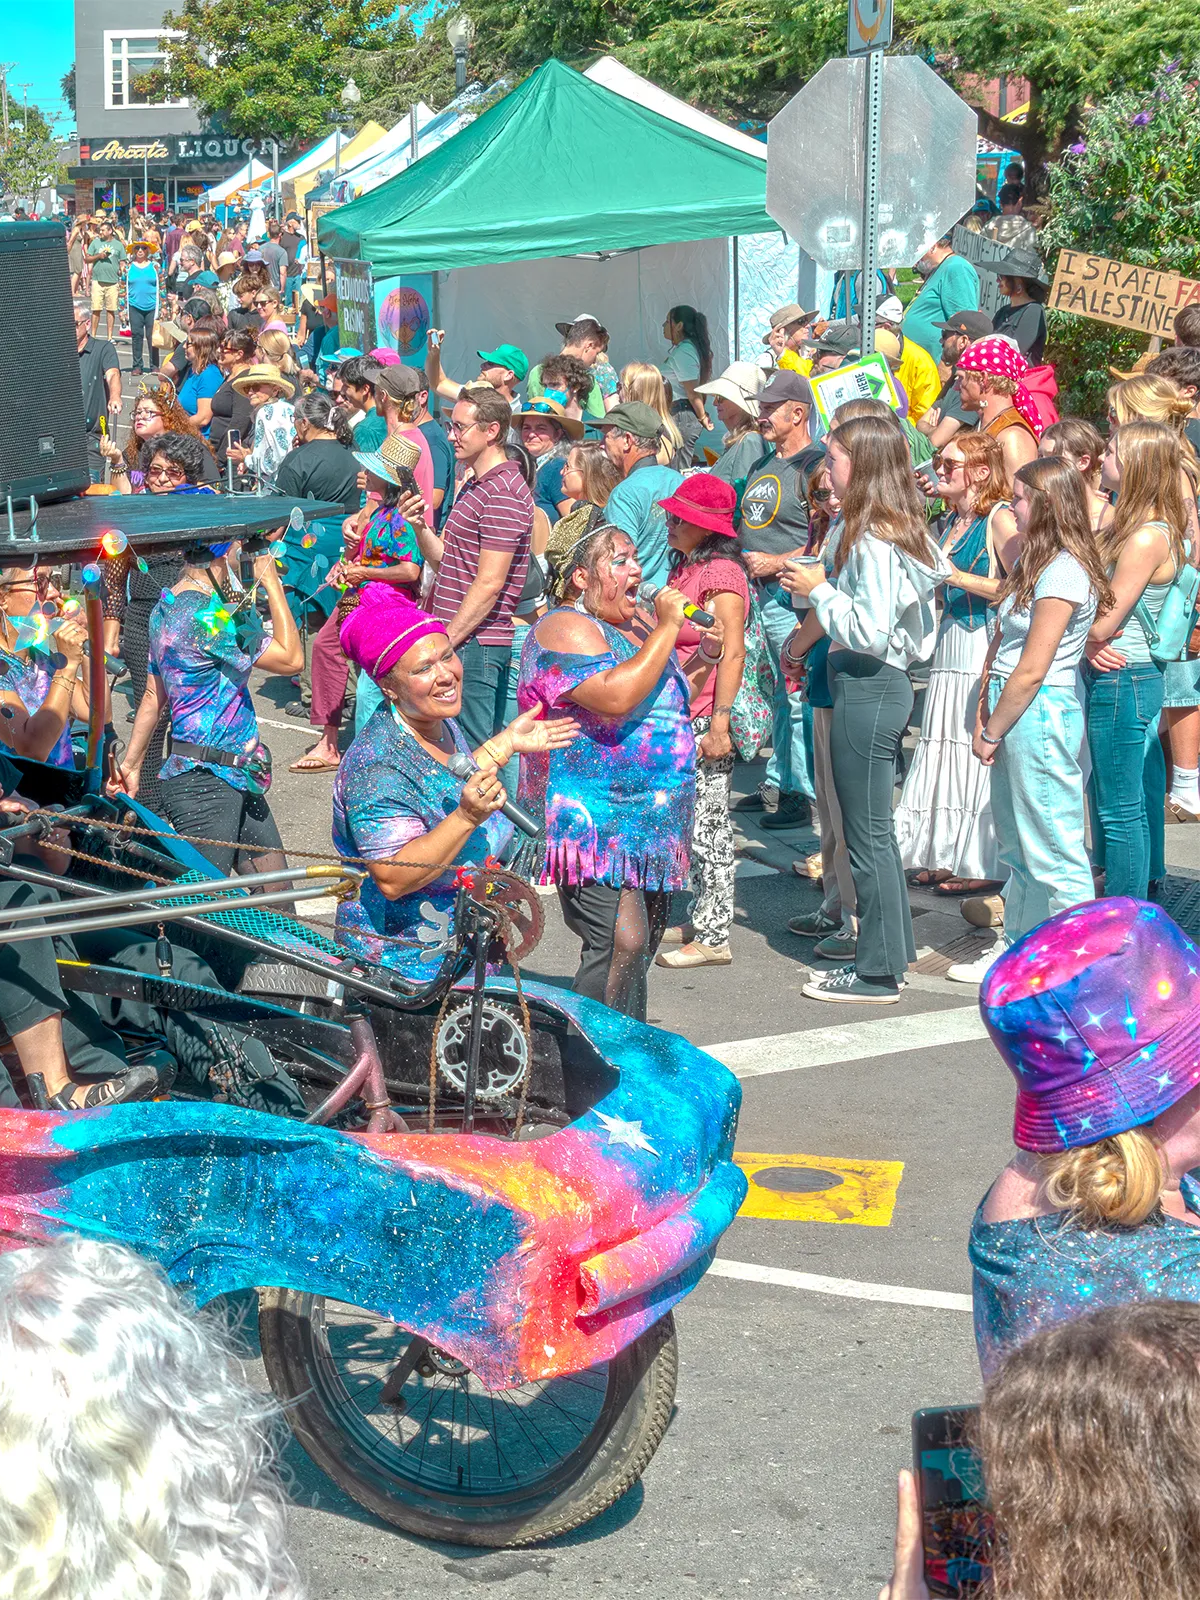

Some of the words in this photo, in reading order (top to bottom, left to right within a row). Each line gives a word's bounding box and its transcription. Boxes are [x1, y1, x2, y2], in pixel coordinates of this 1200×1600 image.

[91, 138, 169, 161] Arcata
[1060, 251, 1168, 300] ISRAEL
[1054, 281, 1178, 332] PALESTINE
[855, 371, 869, 392] HERE
